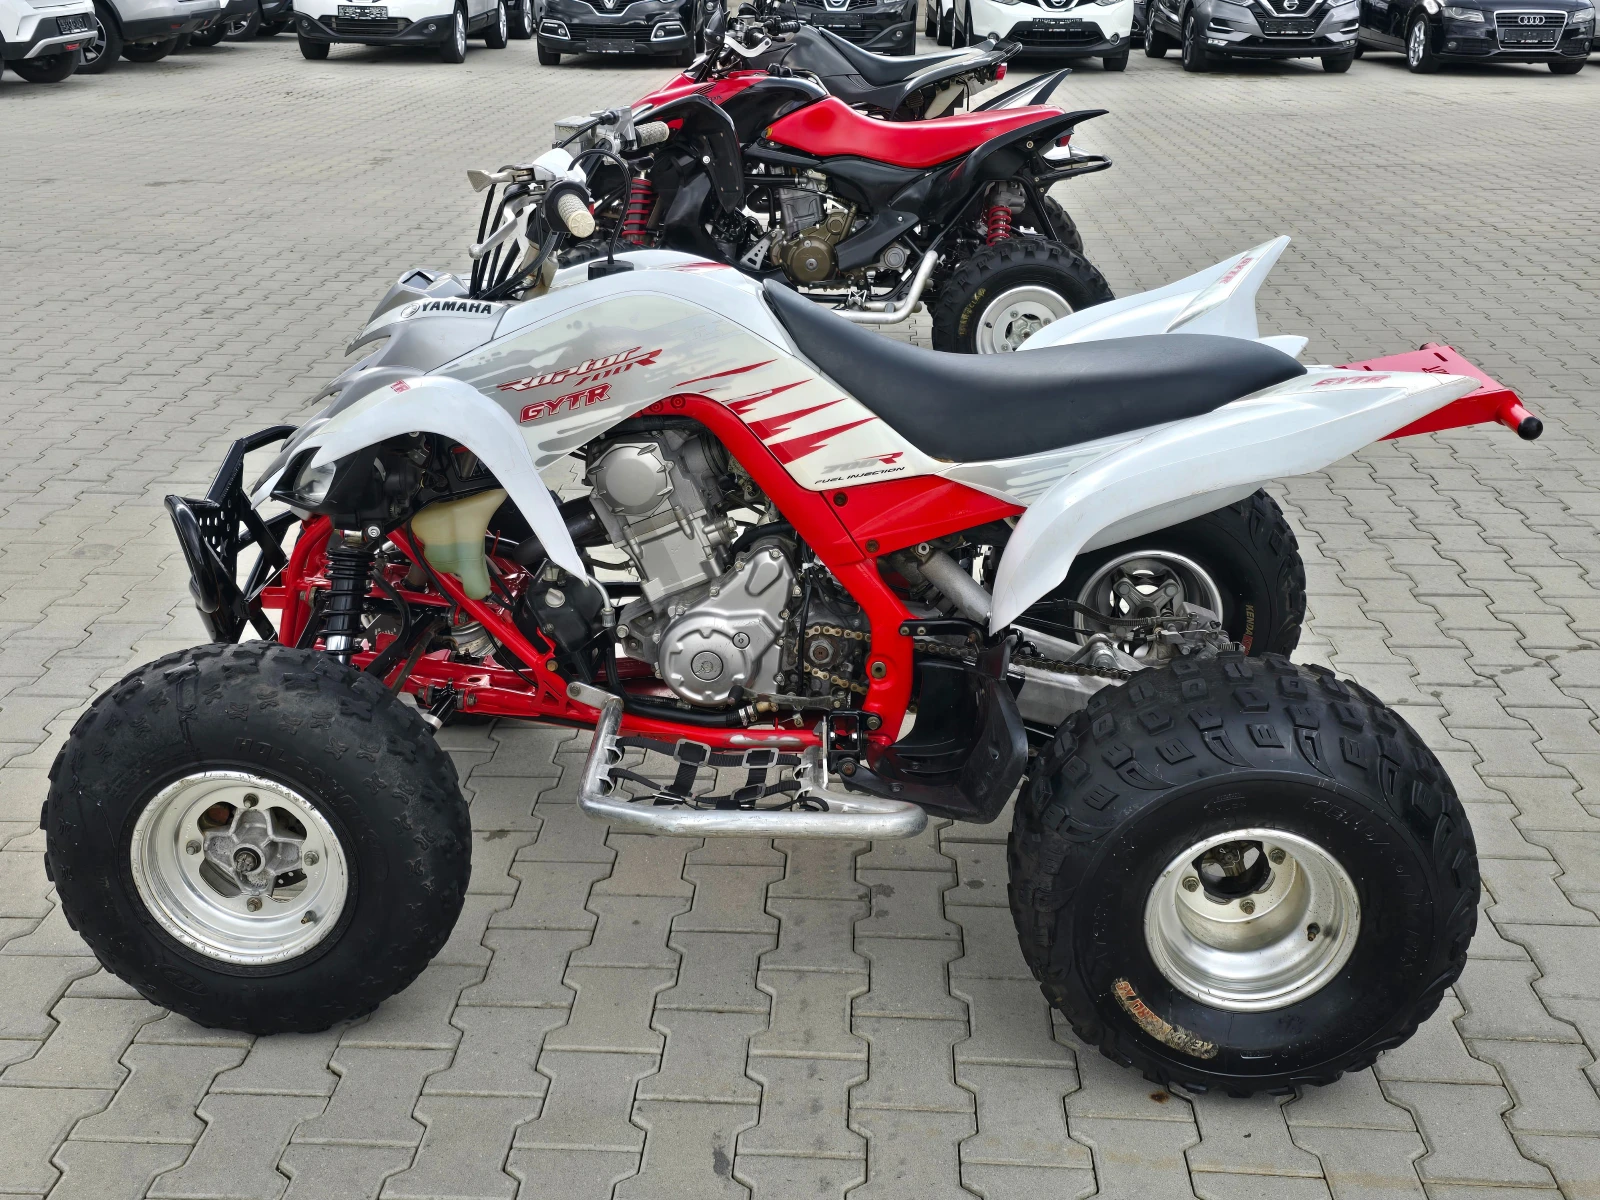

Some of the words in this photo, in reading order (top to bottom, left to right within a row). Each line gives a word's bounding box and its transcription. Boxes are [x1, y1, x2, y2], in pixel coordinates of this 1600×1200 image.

[421, 301, 492, 315] YAMAHA
[519, 382, 613, 424] GYTR
[820, 452, 904, 475] 700R
[814, 476, 844, 485] FUEL
[846, 466, 905, 480] INJECTION
[1245, 604, 1255, 636] KENDA
